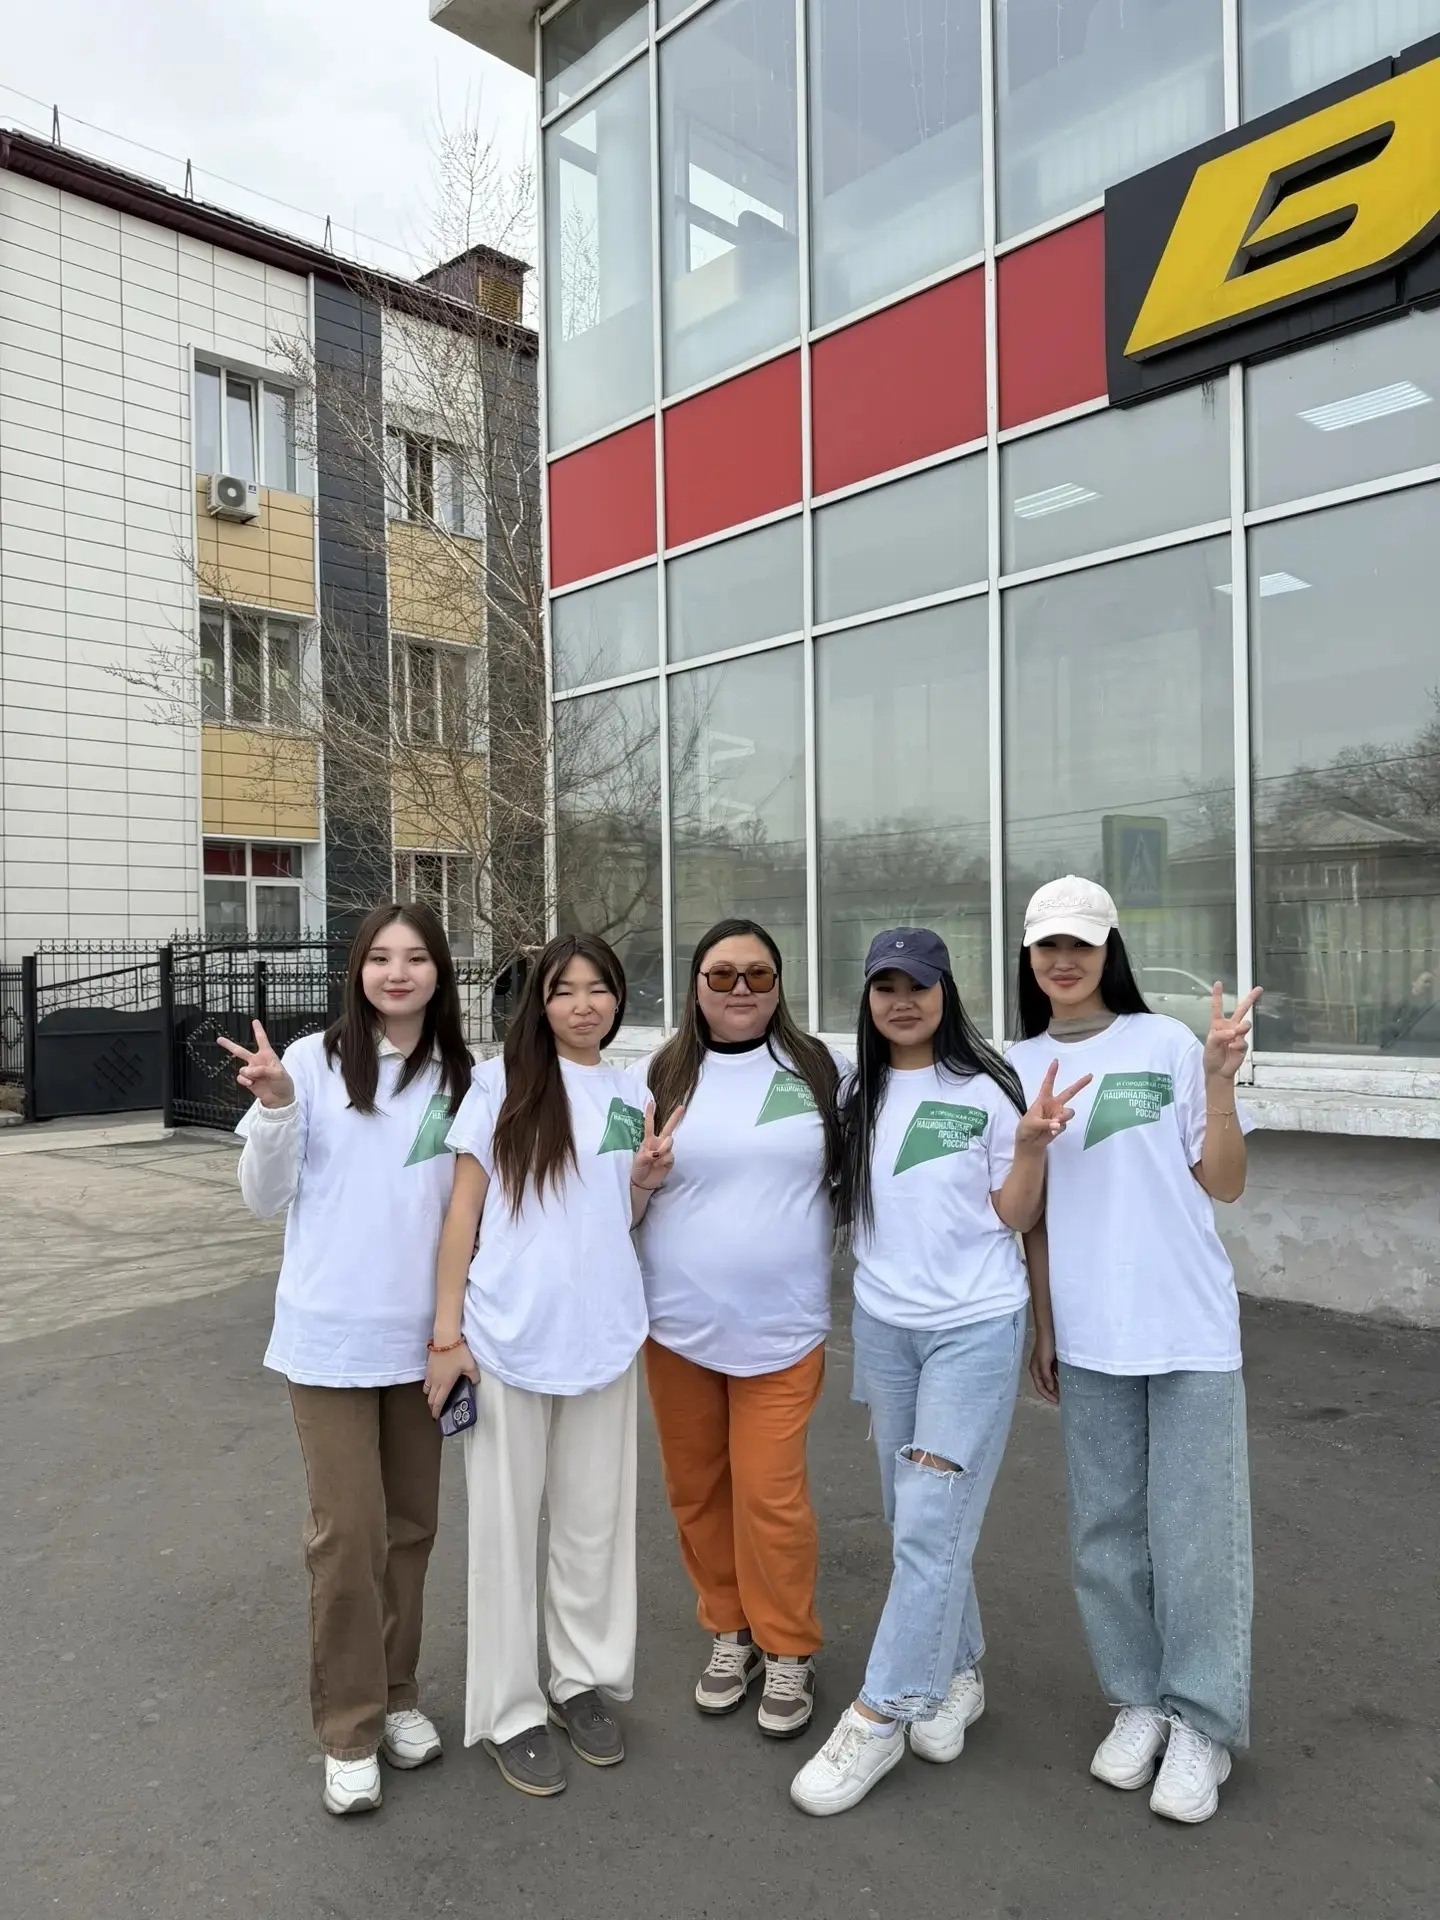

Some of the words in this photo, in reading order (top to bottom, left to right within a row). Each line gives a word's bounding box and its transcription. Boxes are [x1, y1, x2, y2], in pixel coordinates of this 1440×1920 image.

[1103, 1090, 1160, 1102] НАЦИОНАЛЬНЫЕ
[1129, 1099, 1160, 1111] ПРОЕКТЫ
[1135, 1108, 1160, 1120] РОССИИ
[916, 1119, 970, 1133] НАЦИОНАЛЬНЫЕ
[937, 1130, 968, 1141] ПРОЕКТЫ
[942, 1139, 969, 1149] РОССИИ
